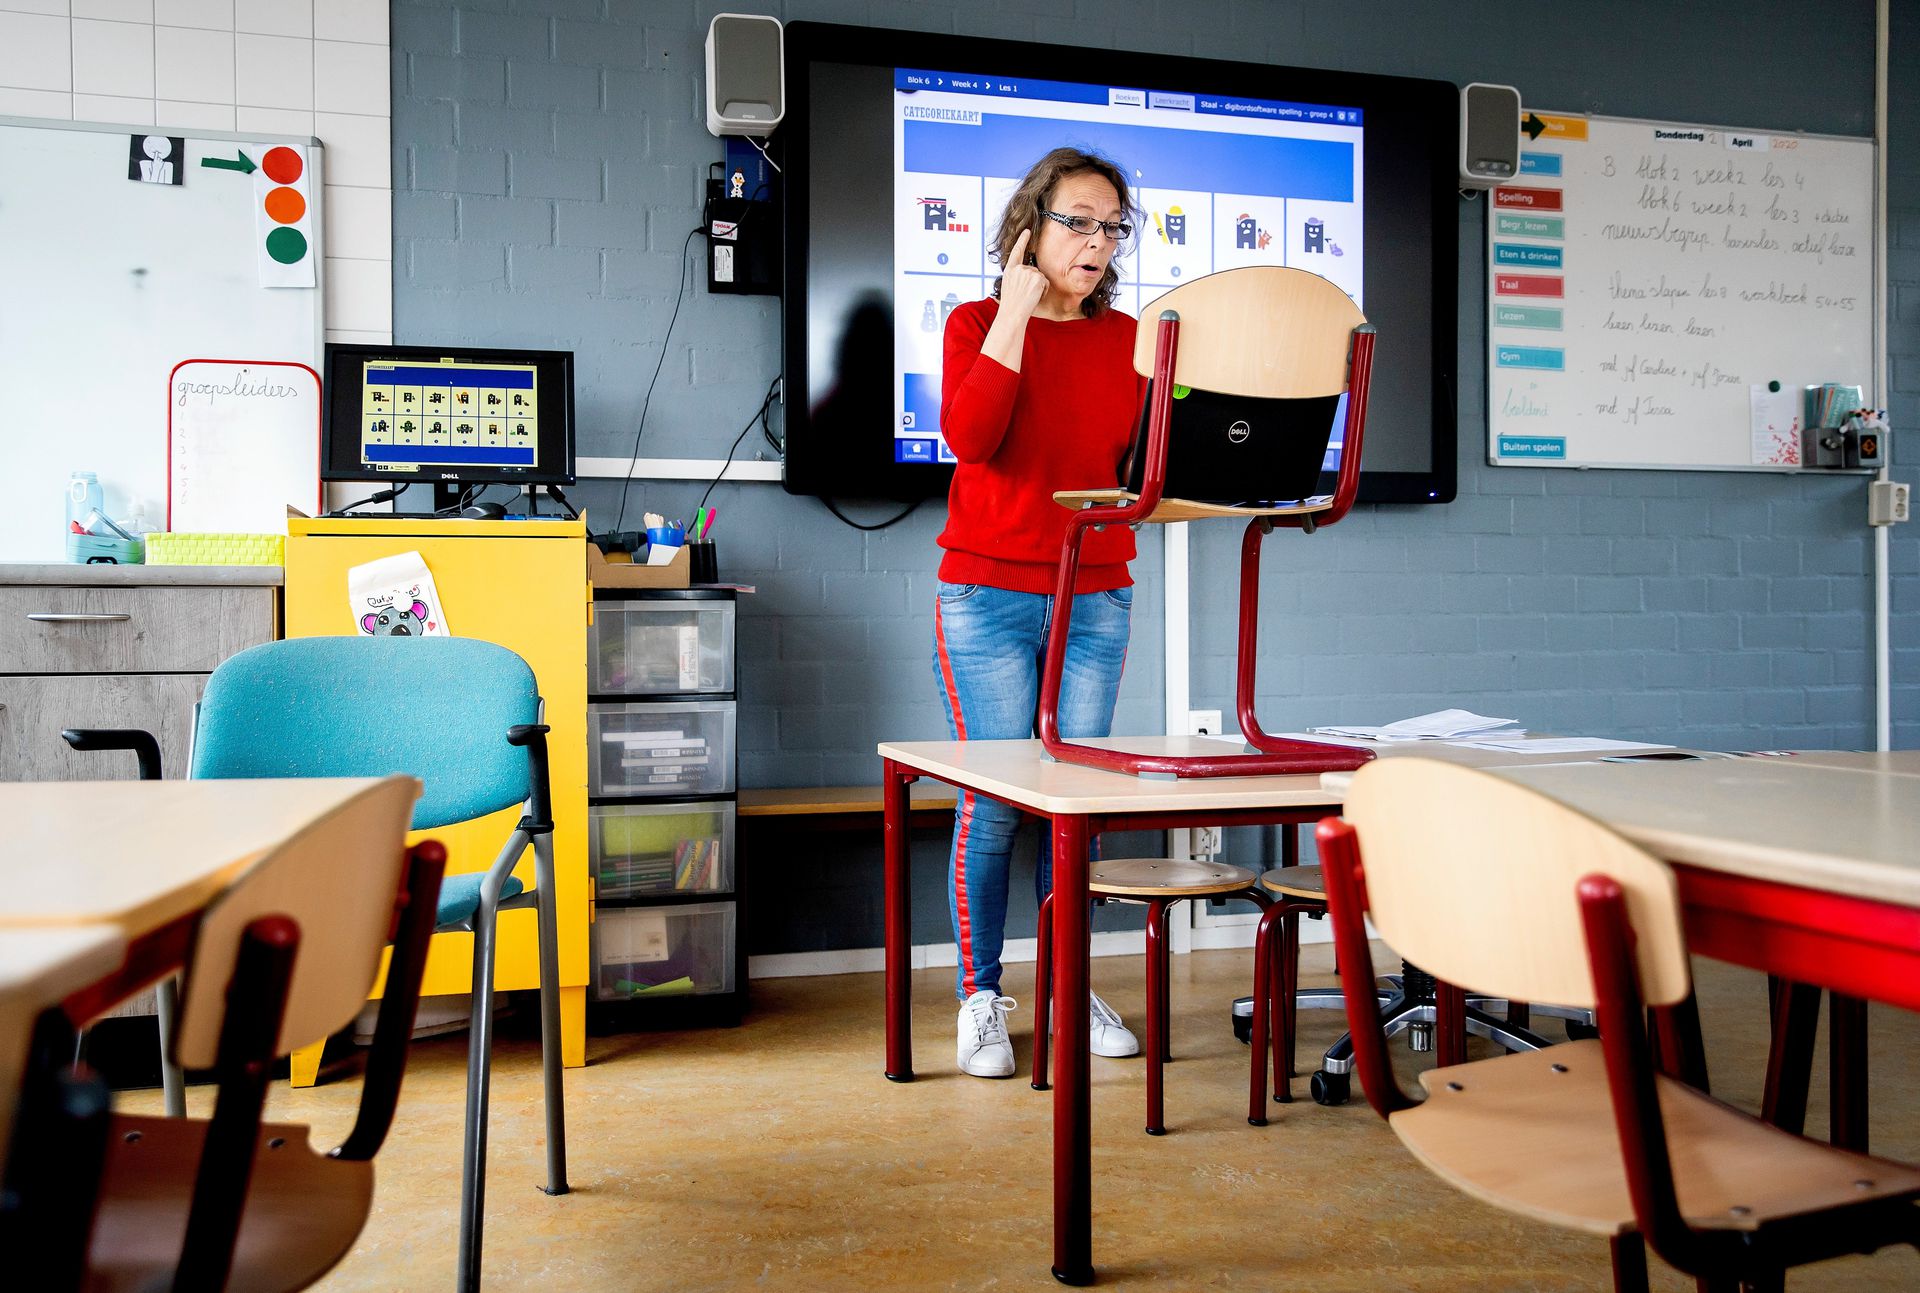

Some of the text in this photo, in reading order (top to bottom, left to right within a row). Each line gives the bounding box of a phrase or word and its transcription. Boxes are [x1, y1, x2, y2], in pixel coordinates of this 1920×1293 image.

[907, 76, 930, 85] Blok 6
[952, 80, 978, 89] Week 4
[999, 84, 1011, 92] Les
[1115, 93, 1139, 102] Boeken
[1154, 97, 1190, 106] Leerkracht
[903, 105, 980, 122] CATEGORIEKAART
[1200, 100, 1218, 109] Staal
[1224, 102, 1277, 115] digibordsoftware
[1278, 107, 1302, 118] spelling
[1309, 110, 1327, 120] groep
[1655, 130, 1704, 142] Donderdag
[1709, 133, 1718, 145] 2
[1732, 137, 1753, 148] April
[1772, 138, 1800, 150] 2020
[1498, 192, 1534, 205] Spelling
[1501, 219, 1548, 231] Begr. lezen
[1500, 249, 1559, 261] Eten & drinken
[1500, 280, 1519, 290] Taal
[1500, 311, 1525, 321] Lezen
[1500, 352, 1520, 362] Gym
[177, 372, 298, 407] groepsleiders
[1503, 442, 1561, 453] Buiten spelen
